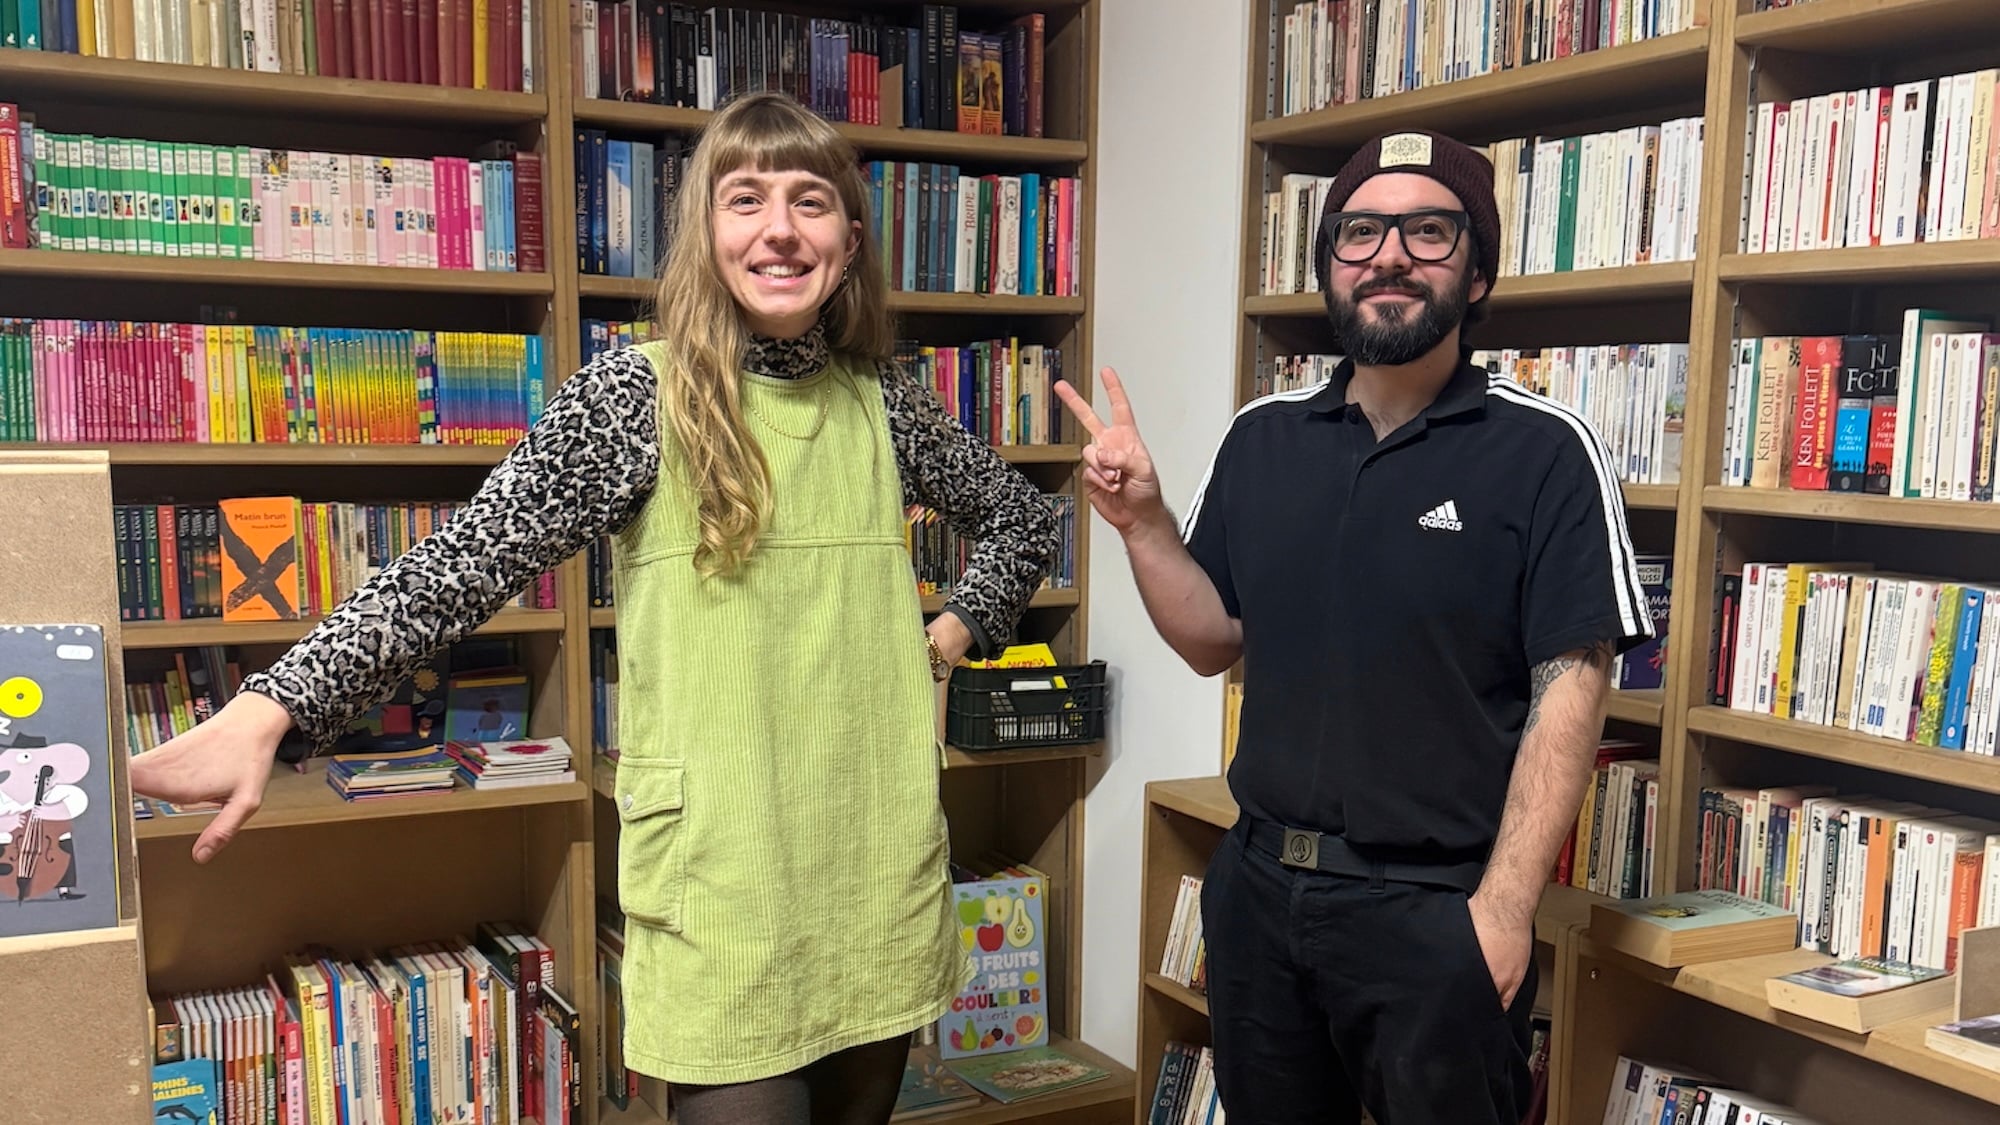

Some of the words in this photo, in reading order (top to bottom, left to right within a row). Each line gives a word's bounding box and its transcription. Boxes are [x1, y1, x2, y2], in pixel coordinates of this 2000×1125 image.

[964, 191, 977, 231] BRIDE
[1775, 373, 1784, 387] feu
[1818, 363, 1831, 404] l'éternité
[1759, 363, 1778, 425] FOLLETT
[1774, 388, 1782, 399] de
[1800, 365, 1819, 429] FOLLETT
[1772, 402, 1781, 433] colonne
[1816, 406, 1827, 418] de
[1770, 437, 1778, 452] Une
[1815, 420, 1826, 450] portes
[1756, 431, 1771, 461] KEN
[1797, 434, 1813, 467] KEN
[1813, 451, 1824, 469] Aux
[234, 513, 261, 521] Matin
[1418, 514, 1463, 532] adidas
[982, 951, 1040, 971] FRUITS
[988, 972, 1019, 989] DES
[415, 986, 425, 1010] savoir
[416, 1016, 426, 1042] choses
[417, 1045, 427, 1062] 365
[152, 1077, 189, 1090] PHINS
